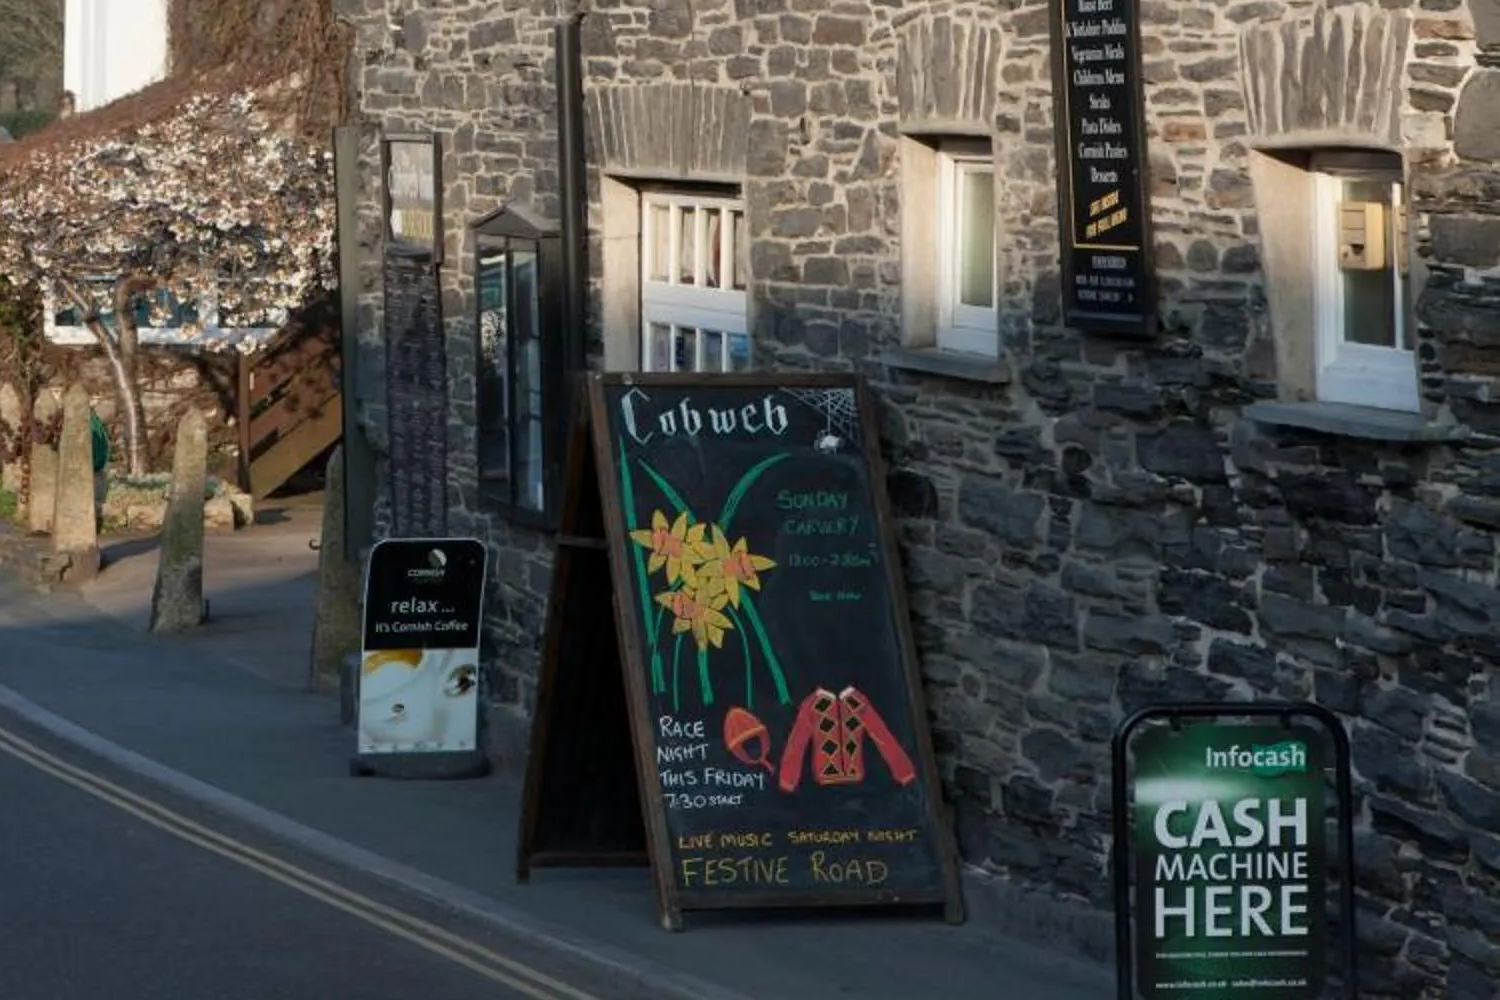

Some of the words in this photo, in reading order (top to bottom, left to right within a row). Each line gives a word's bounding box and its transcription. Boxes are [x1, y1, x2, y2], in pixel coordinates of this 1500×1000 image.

[621, 386, 789, 446] Cobweb
[392, 620, 432, 633] Cornish
[434, 620, 469, 632] Coffee
[659, 716, 705, 739] RACE
[657, 743, 709, 765] NIGHT
[1206, 744, 1306, 768] Infocash
[660, 769, 697, 788] THIS
[703, 767, 764, 790] FRIDAY
[1154, 797, 1308, 849] CASH
[678, 834, 711, 849] LIVE
[721, 831, 772, 848] MUSIC
[787, 830, 859, 844] SATURDAY
[680, 856, 789, 887] FESTIVE
[811, 851, 889, 885] ROAD
[1155, 851, 1309, 881] MACHINE
[1155, 885, 1309, 938] HERE
